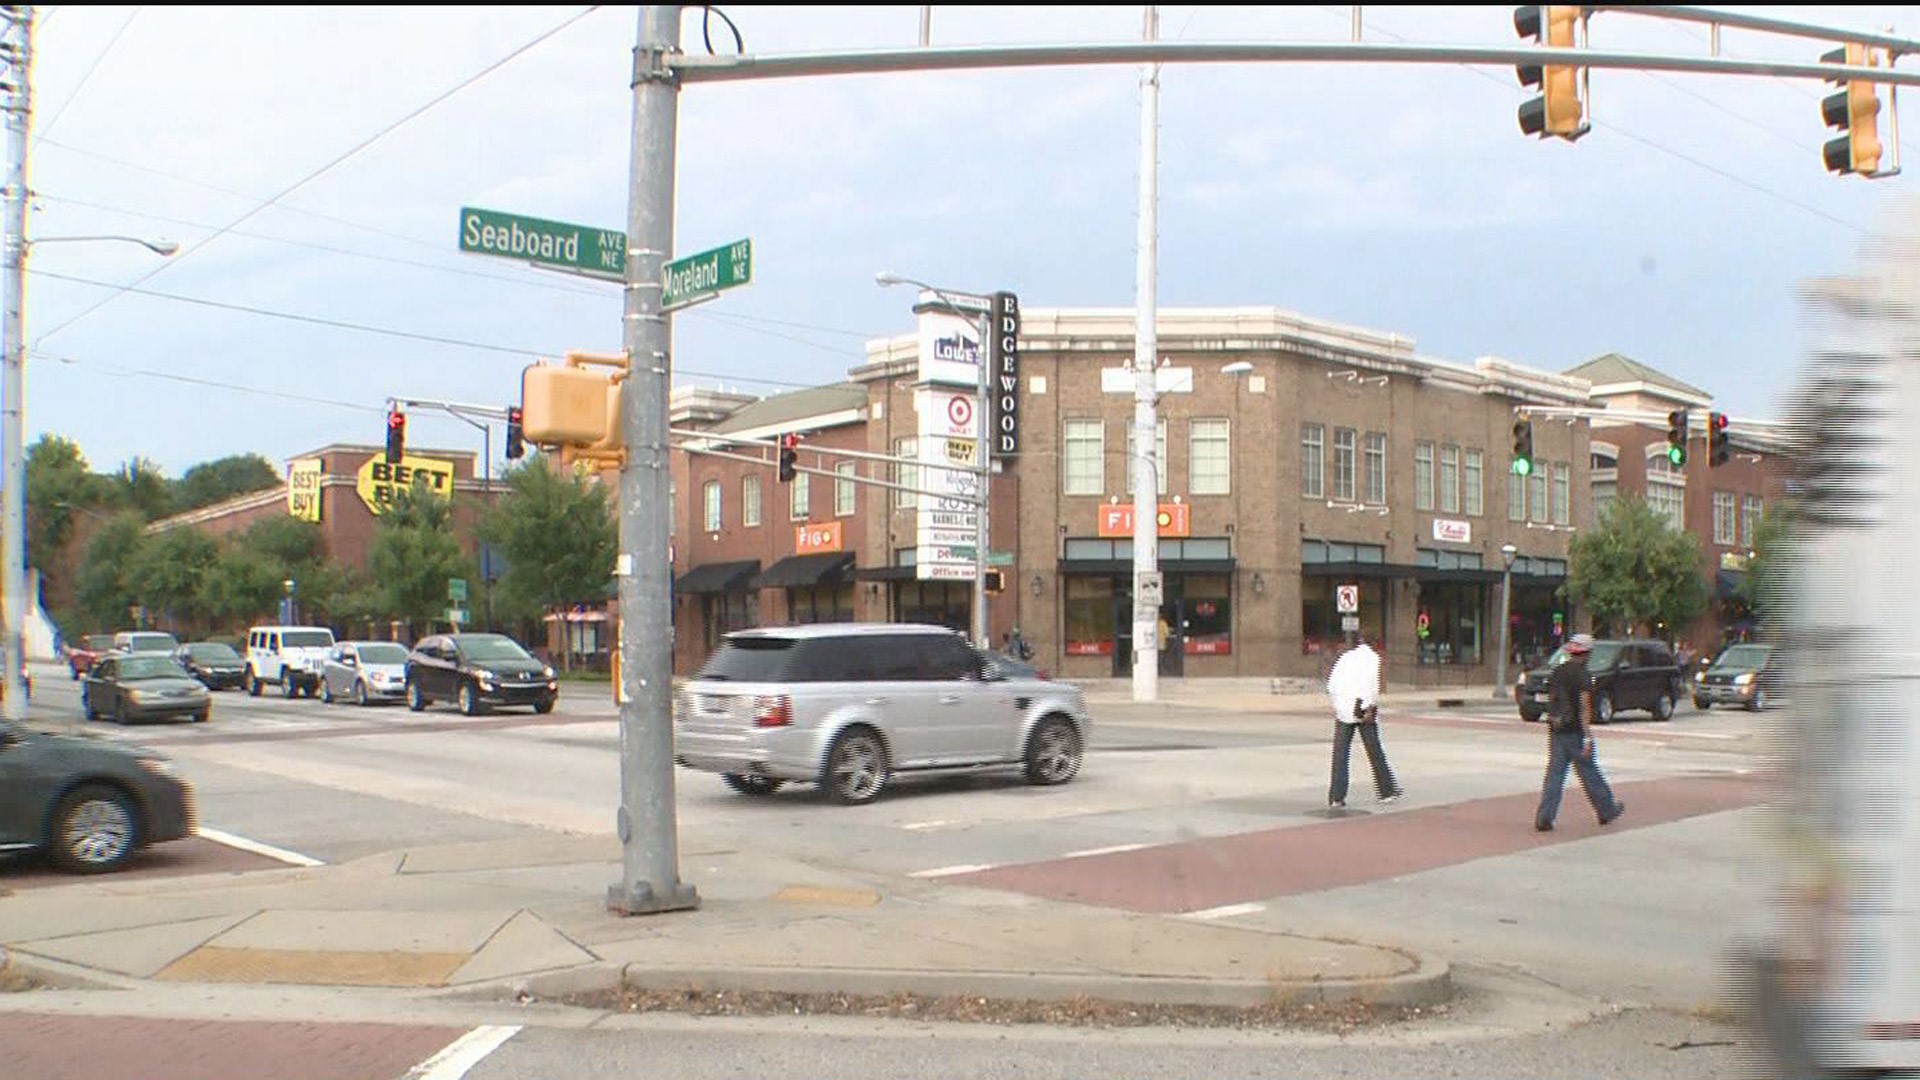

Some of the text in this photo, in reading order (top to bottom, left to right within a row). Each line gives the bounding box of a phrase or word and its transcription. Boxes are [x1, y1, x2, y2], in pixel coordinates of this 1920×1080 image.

[464, 215, 579, 263] Seaboard
[599, 231, 624, 251] AVE
[601, 251, 619, 269] NE
[730, 241, 749, 262] AVE
[663, 254, 718, 299] Moreland
[732, 261, 747, 281] NE
[1000, 298, 1016, 452] EDGEWOOD
[293, 471, 319, 489] BEST
[372, 462, 449, 489] BEST
[293, 492, 316, 515] BUY
[939, 497, 976, 511] ROS
[1108, 511, 1171, 531] FIO
